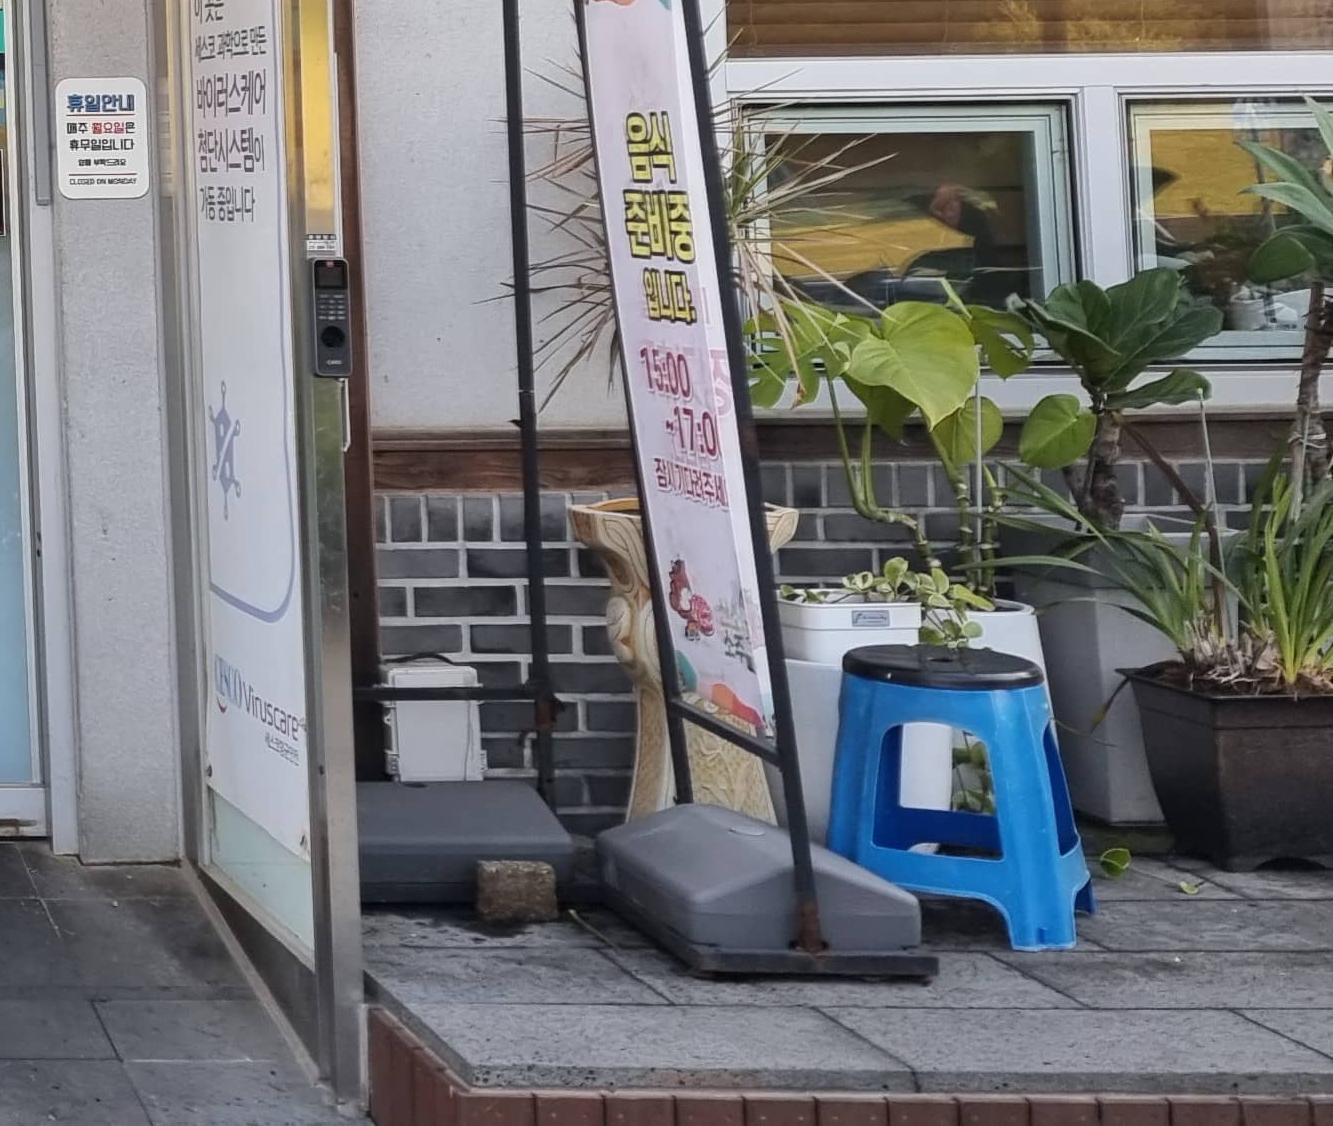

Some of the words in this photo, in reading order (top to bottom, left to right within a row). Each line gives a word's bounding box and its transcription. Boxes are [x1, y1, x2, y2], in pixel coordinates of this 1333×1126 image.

[217, 29, 249, 60] 과학으로
[249, 26, 267, 55] 만든
[67, 94, 134, 112] 휴일안내
[196, 68, 266, 119] 바이러스케어
[67, 122, 88, 134] 매주
[92, 122, 135, 134] 월요일은
[69, 139, 135, 151] 휴무일입니다
[198, 127, 264, 173] 첨단시스템이
[626, 110, 677, 184] 음식
[623, 188, 696, 264] 준비중
[640, 346, 691, 399] 15:00
